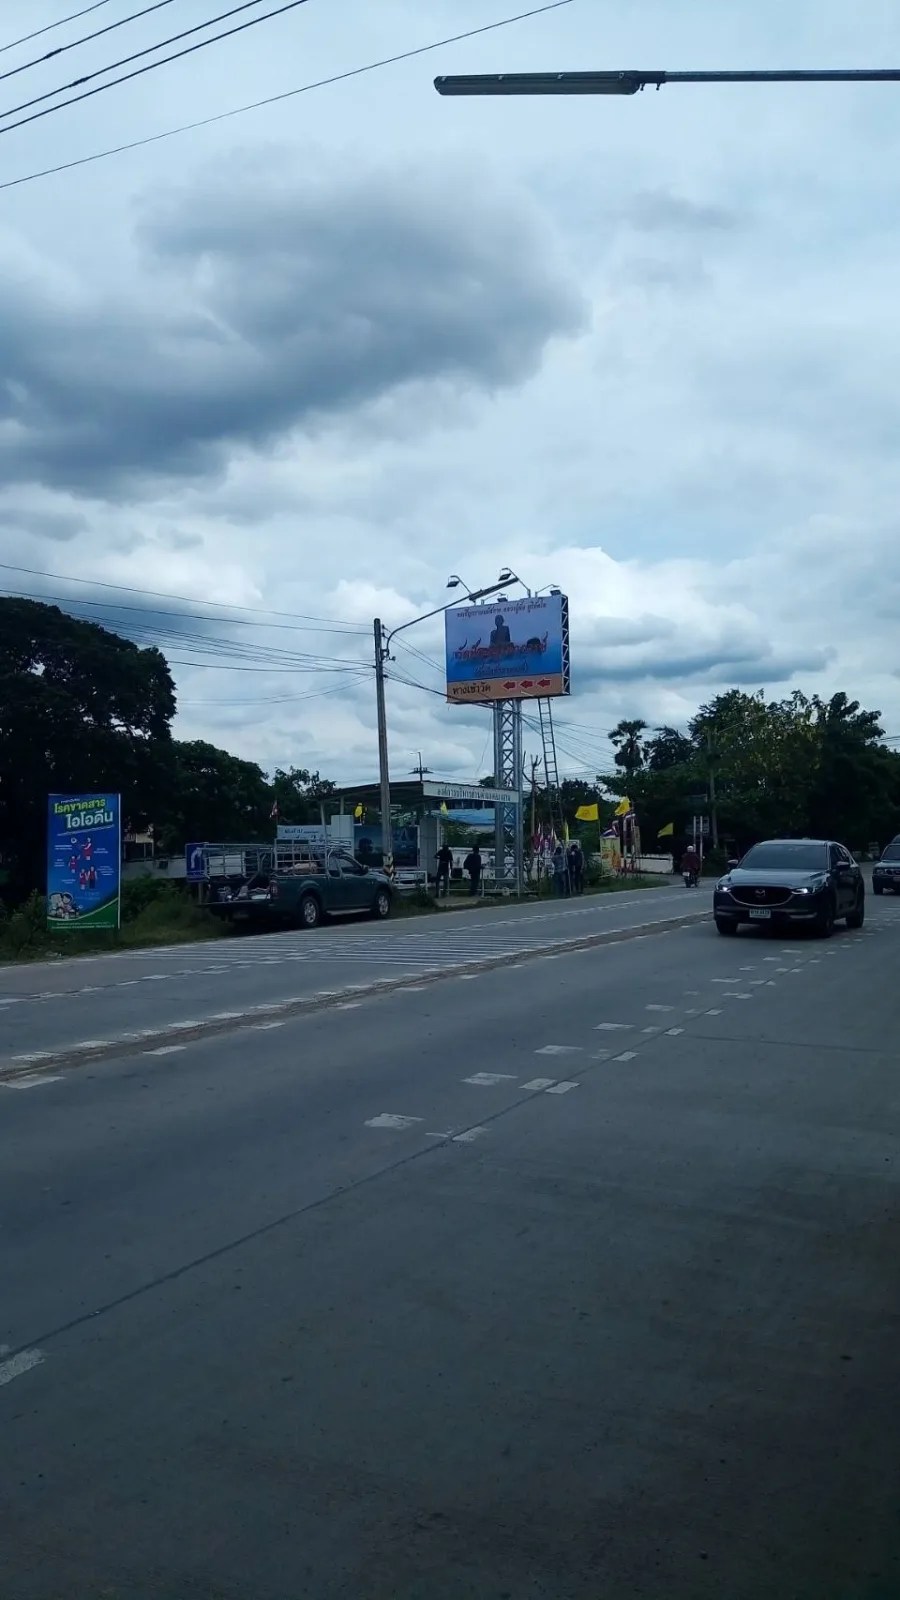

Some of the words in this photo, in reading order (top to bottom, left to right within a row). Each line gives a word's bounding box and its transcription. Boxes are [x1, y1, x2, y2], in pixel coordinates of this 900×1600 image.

[452, 682, 491, 695] ทางเข้าวัด
[54, 799, 106, 814] โรคขาดสาร
[65, 808, 114, 829] ไอโอดีน
